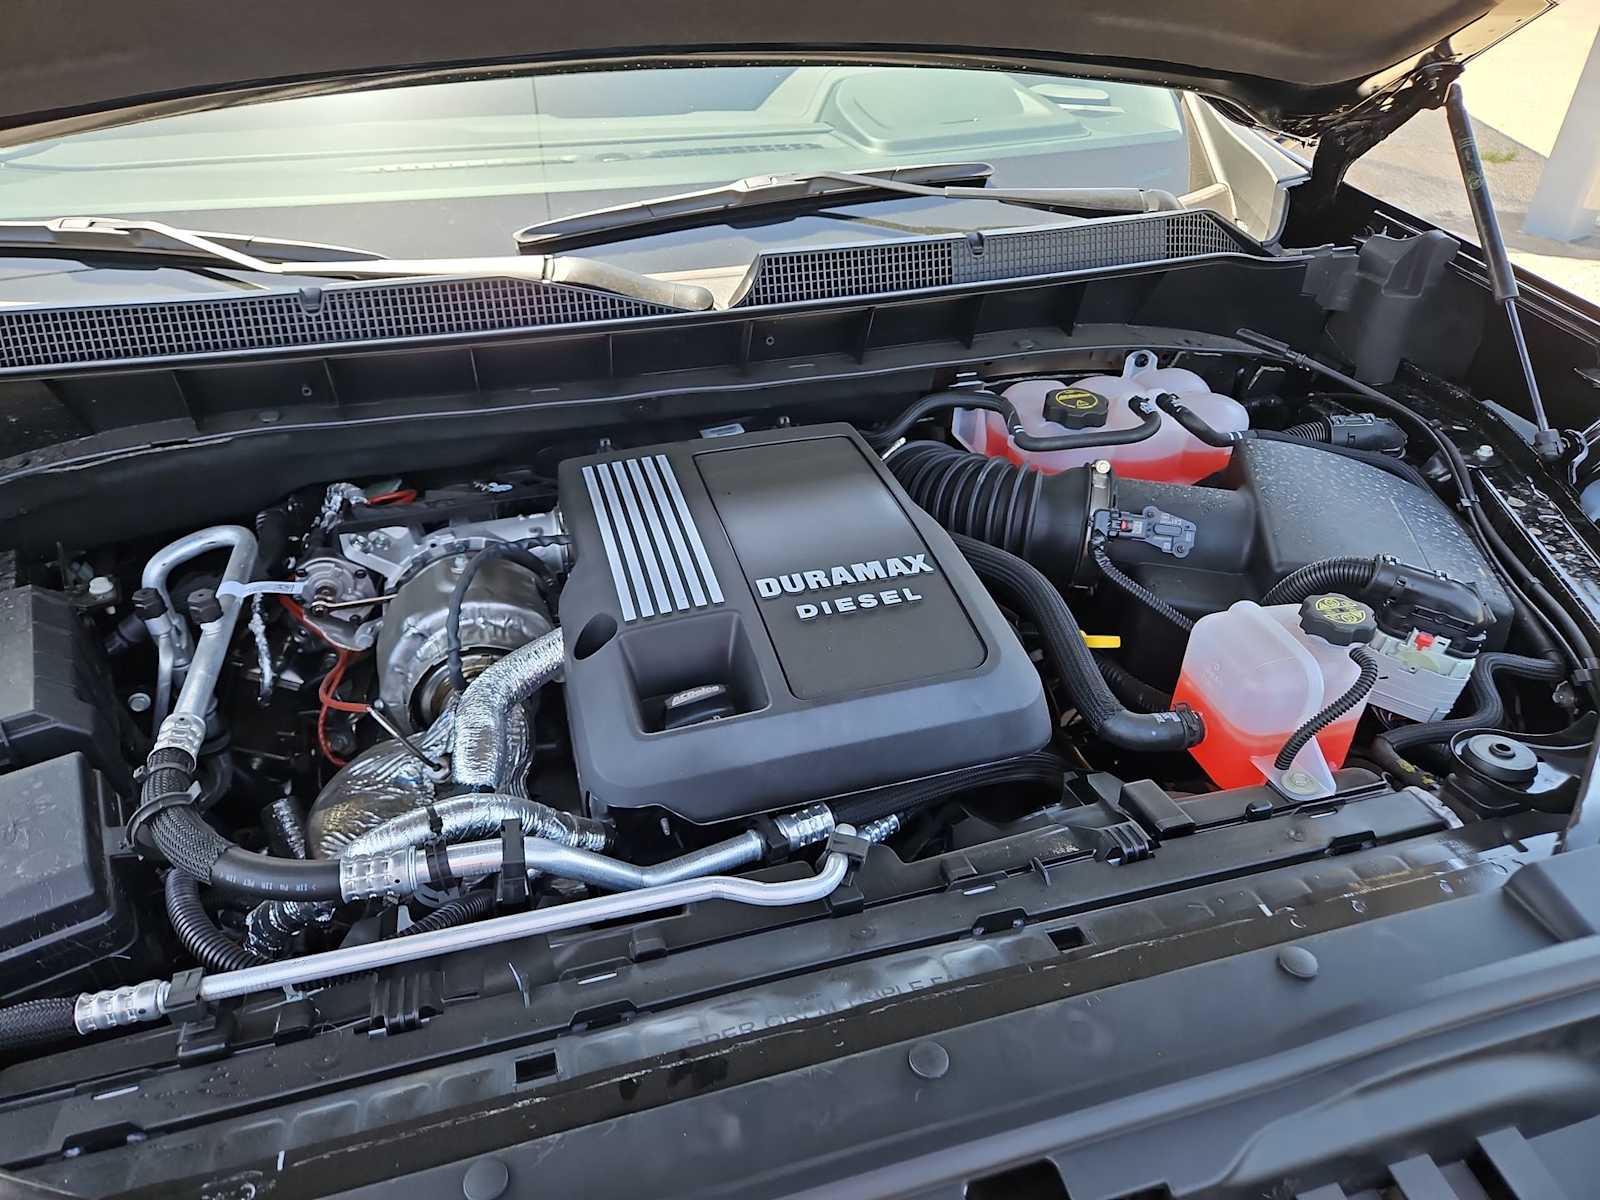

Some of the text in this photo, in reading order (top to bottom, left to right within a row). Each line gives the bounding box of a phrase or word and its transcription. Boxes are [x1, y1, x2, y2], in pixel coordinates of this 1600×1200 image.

[755, 553, 935, 599] DURAMAX
[795, 587, 923, 620] DIESEL
[671, 685, 720, 707] ACDelco
